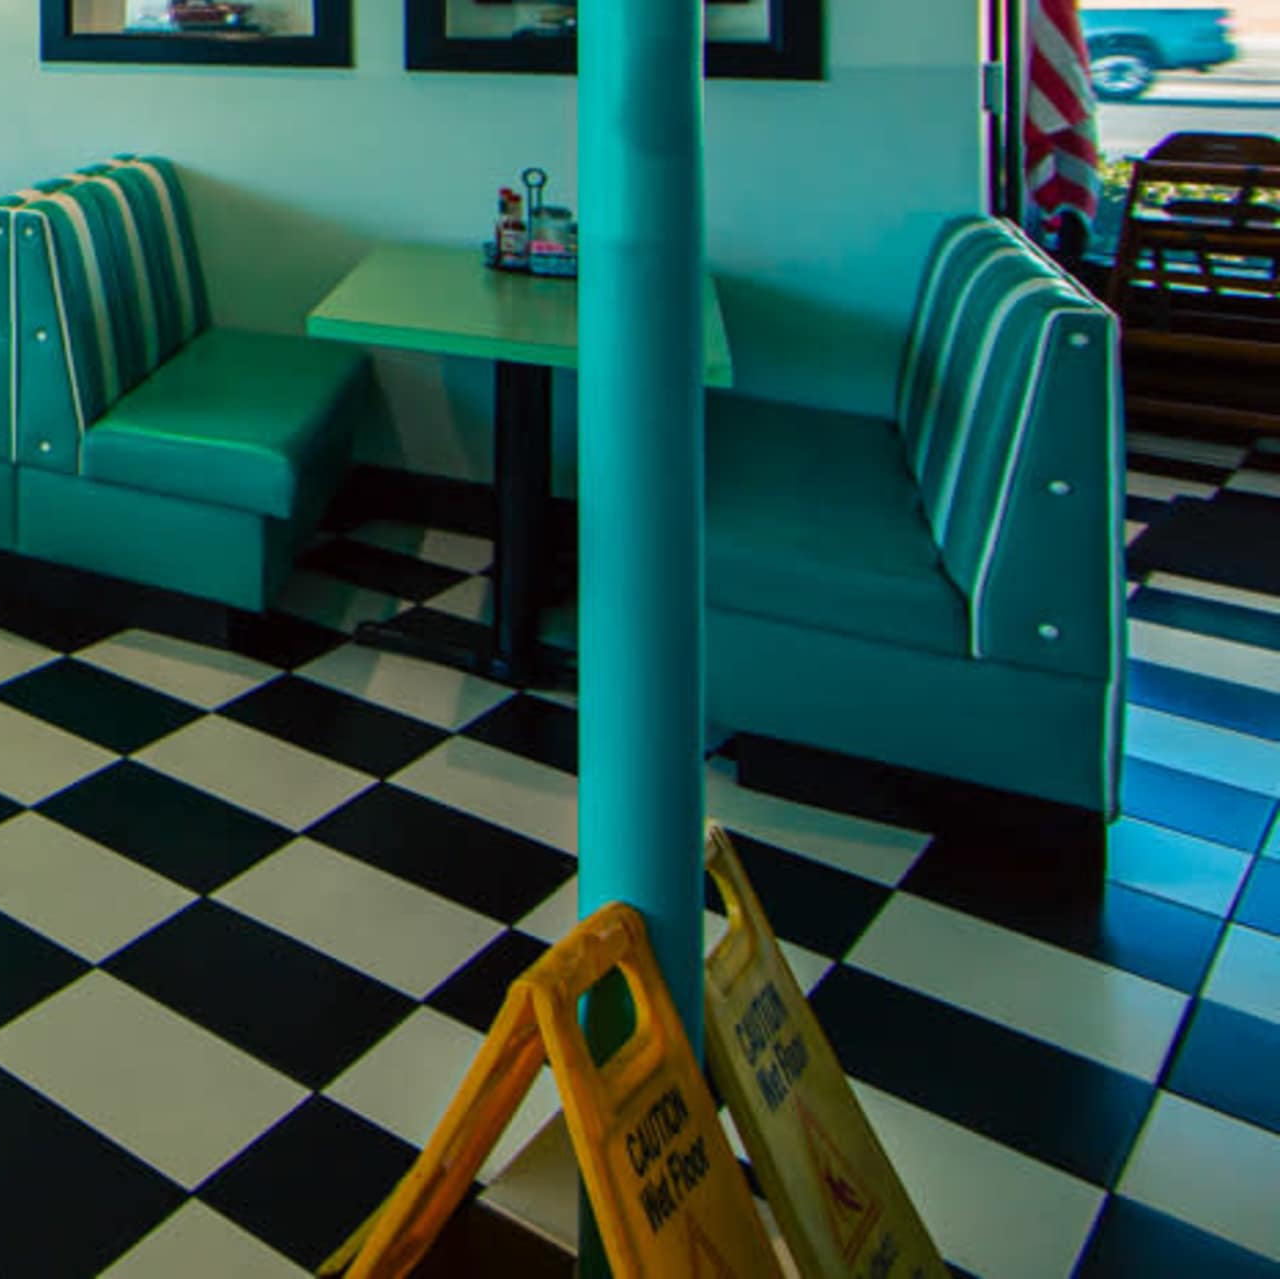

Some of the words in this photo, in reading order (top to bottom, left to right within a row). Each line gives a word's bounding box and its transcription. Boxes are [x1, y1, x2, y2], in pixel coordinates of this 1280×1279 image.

[736, 981, 787, 1067] CAUTION
[626, 1087, 689, 1179] CAUTION
[640, 1173, 678, 1234] Wet
[667, 1135, 710, 1201] Floor
